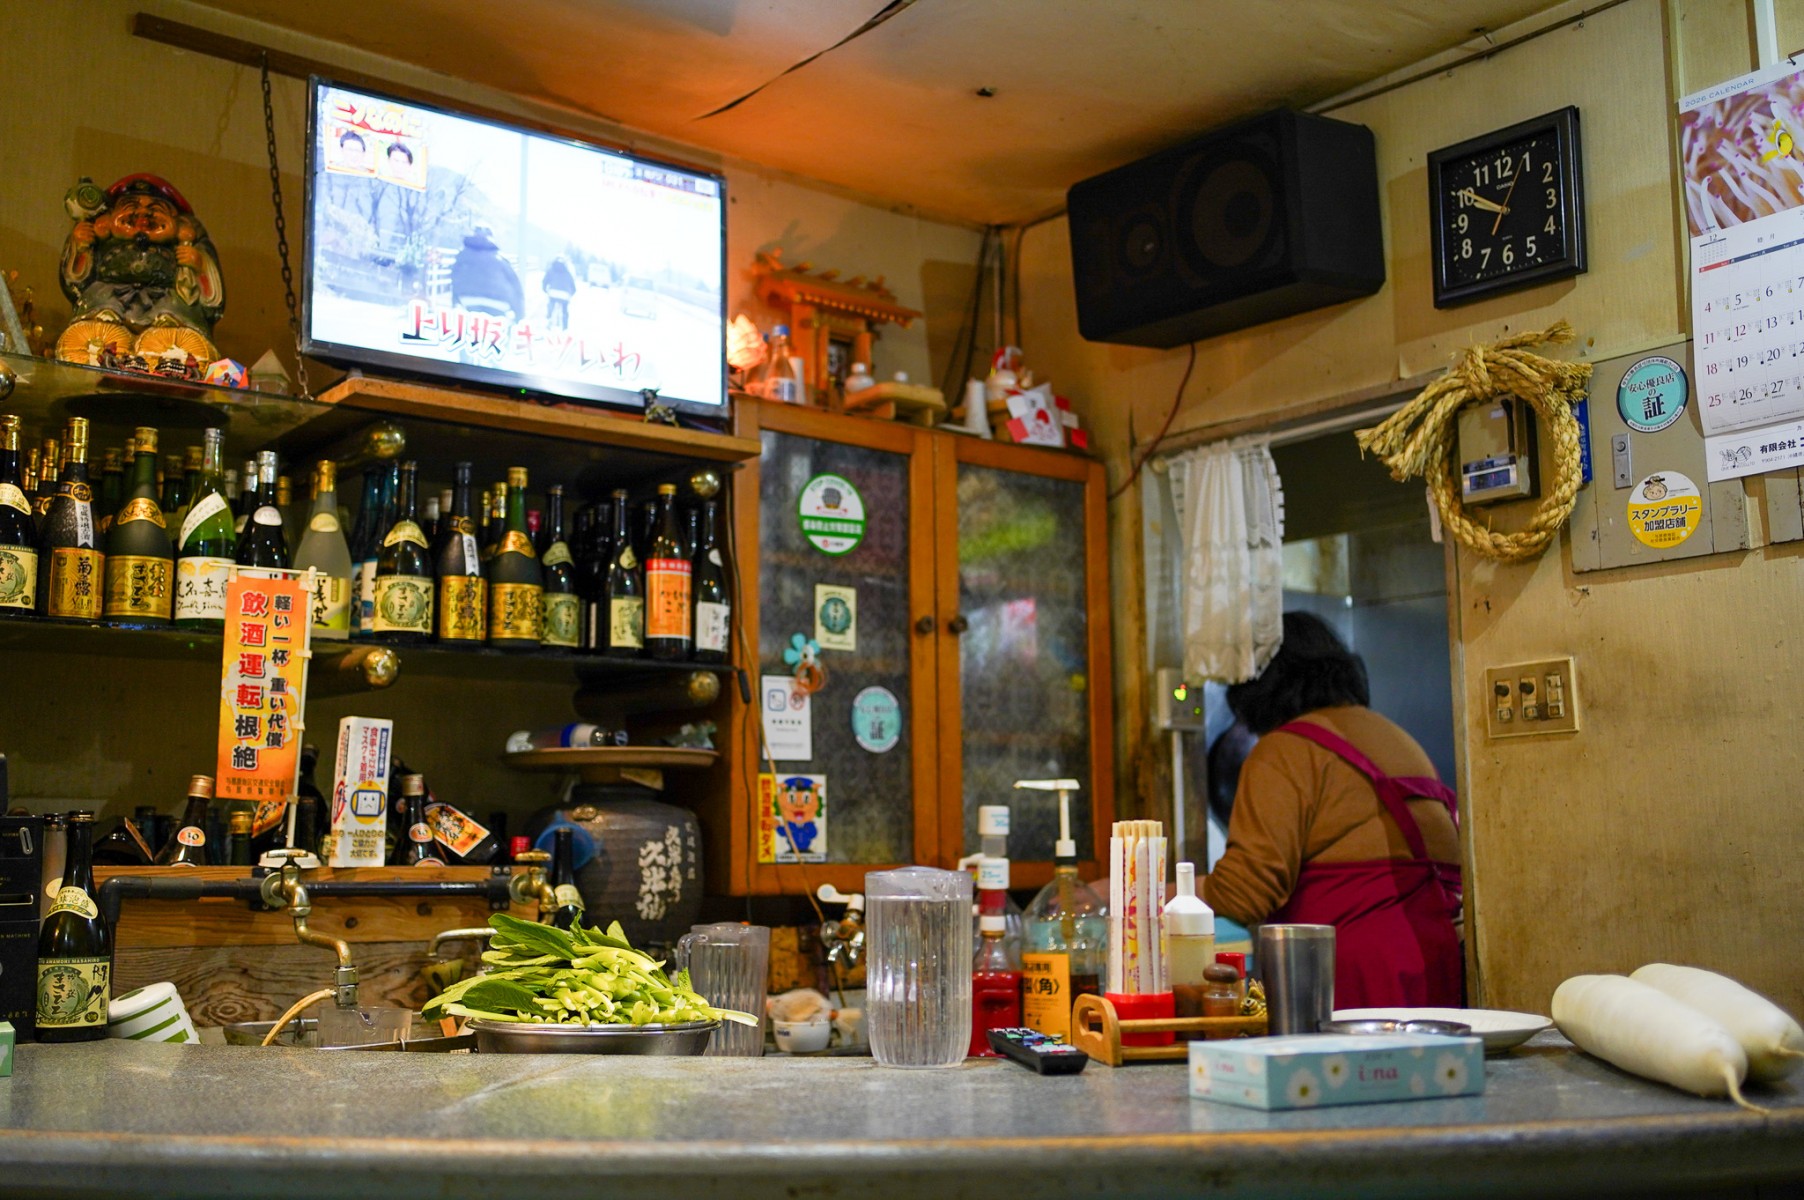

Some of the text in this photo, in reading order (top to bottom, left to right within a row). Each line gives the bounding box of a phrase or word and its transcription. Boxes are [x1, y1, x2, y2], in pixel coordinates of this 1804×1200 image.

[1685, 78, 1755, 108] 2026 CALENDAR
[1494, 156, 1513, 179] 12
[1522, 151, 1531, 172] 1
[1473, 164, 1490, 187] 11
[1542, 162, 1553, 183] 2
[1456, 186, 1475, 209] 10
[1546, 188, 1557, 209] 3
[1457, 214, 1468, 234] 9
[1544, 214, 1556, 235] 4
[1461, 238, 1472, 259] 8
[1502, 244, 1514, 265] 6
[1525, 235, 1537, 257] 5
[1480, 247, 1491, 270] 7
[1704, 302, 1711, 313] 4
[1735, 294, 1742, 306] 5
[1766, 285, 1773, 297] 6
[1705, 332, 1714, 344] 11
[1736, 324, 1746, 337] 12
[1766, 316, 1777, 329] 13
[1707, 363, 1718, 375] 18
[1737, 355, 1748, 368] 19
[1766, 348, 1780, 361] 20
[1628, 372, 1675, 393] 安心優良店
[1648, 388, 1656, 396] の
[1708, 380, 1783, 407] 25 26 27
[1642, 393, 1666, 420] 証
[1760, 439, 1797, 454] 有限会社
[1632, 504, 1698, 521] スタンプラリー
[1644, 516, 1686, 532] 加盟店舗
[233, 592, 267, 769] 飲酒運転根絶
